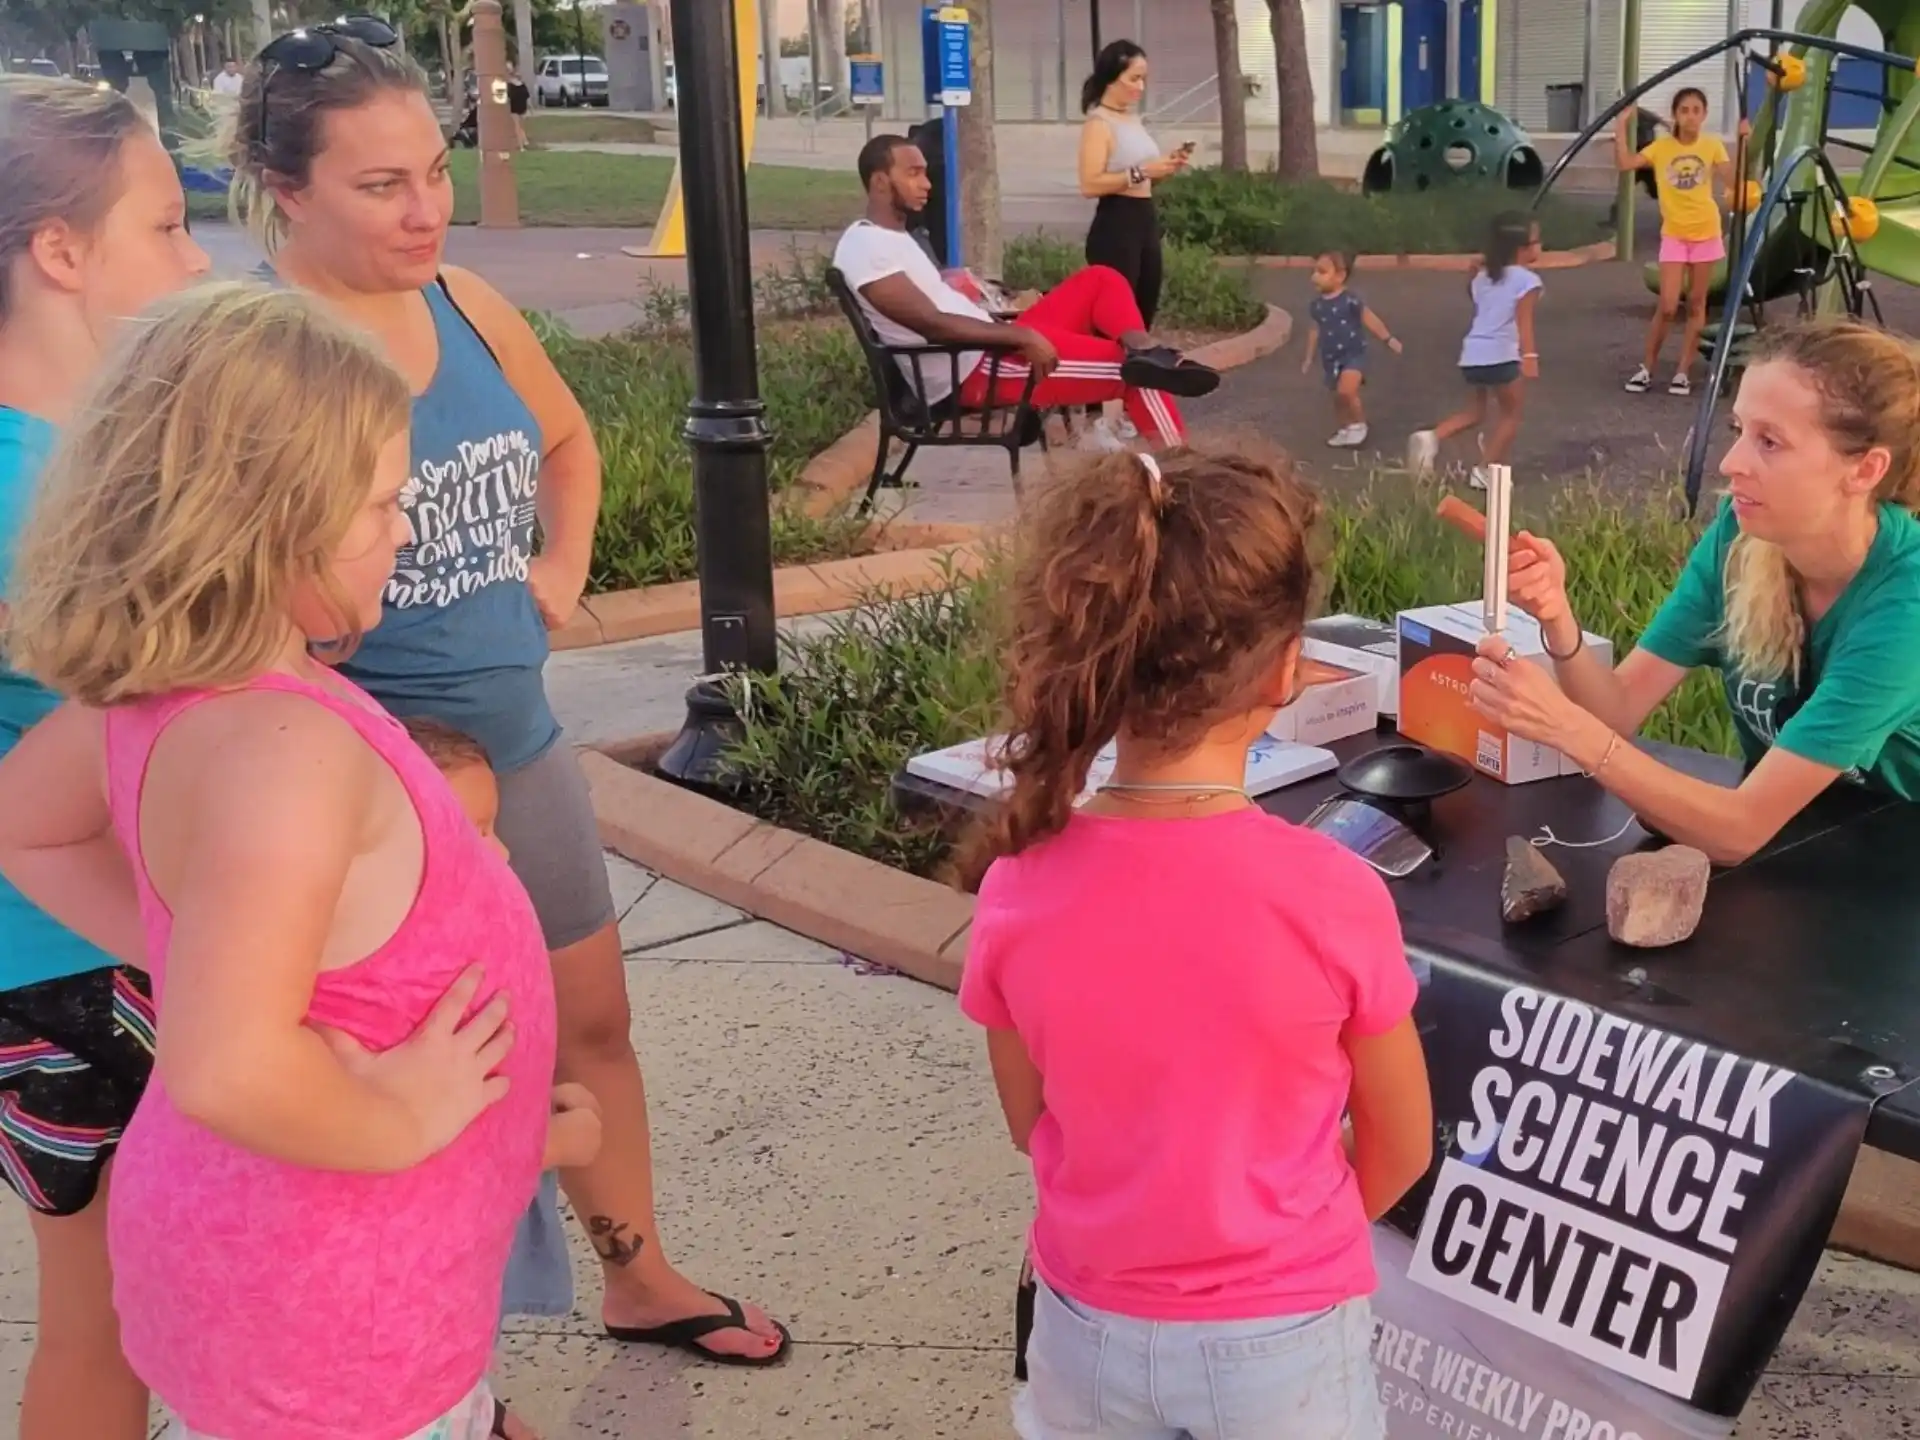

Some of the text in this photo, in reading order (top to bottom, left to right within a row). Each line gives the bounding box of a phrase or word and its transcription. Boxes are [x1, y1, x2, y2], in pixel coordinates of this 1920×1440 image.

[416, 530, 463, 566] CAN
[1430, 671, 1471, 698] ASTRO
[1489, 986, 1796, 1148] SIDEWALK
[1457, 1066, 1764, 1255] SCIENCE
[1431, 1183, 1698, 1373] CENTER
[1430, 1345, 1545, 1433] WEEKLY
[1541, 1398, 1642, 1440] PR
